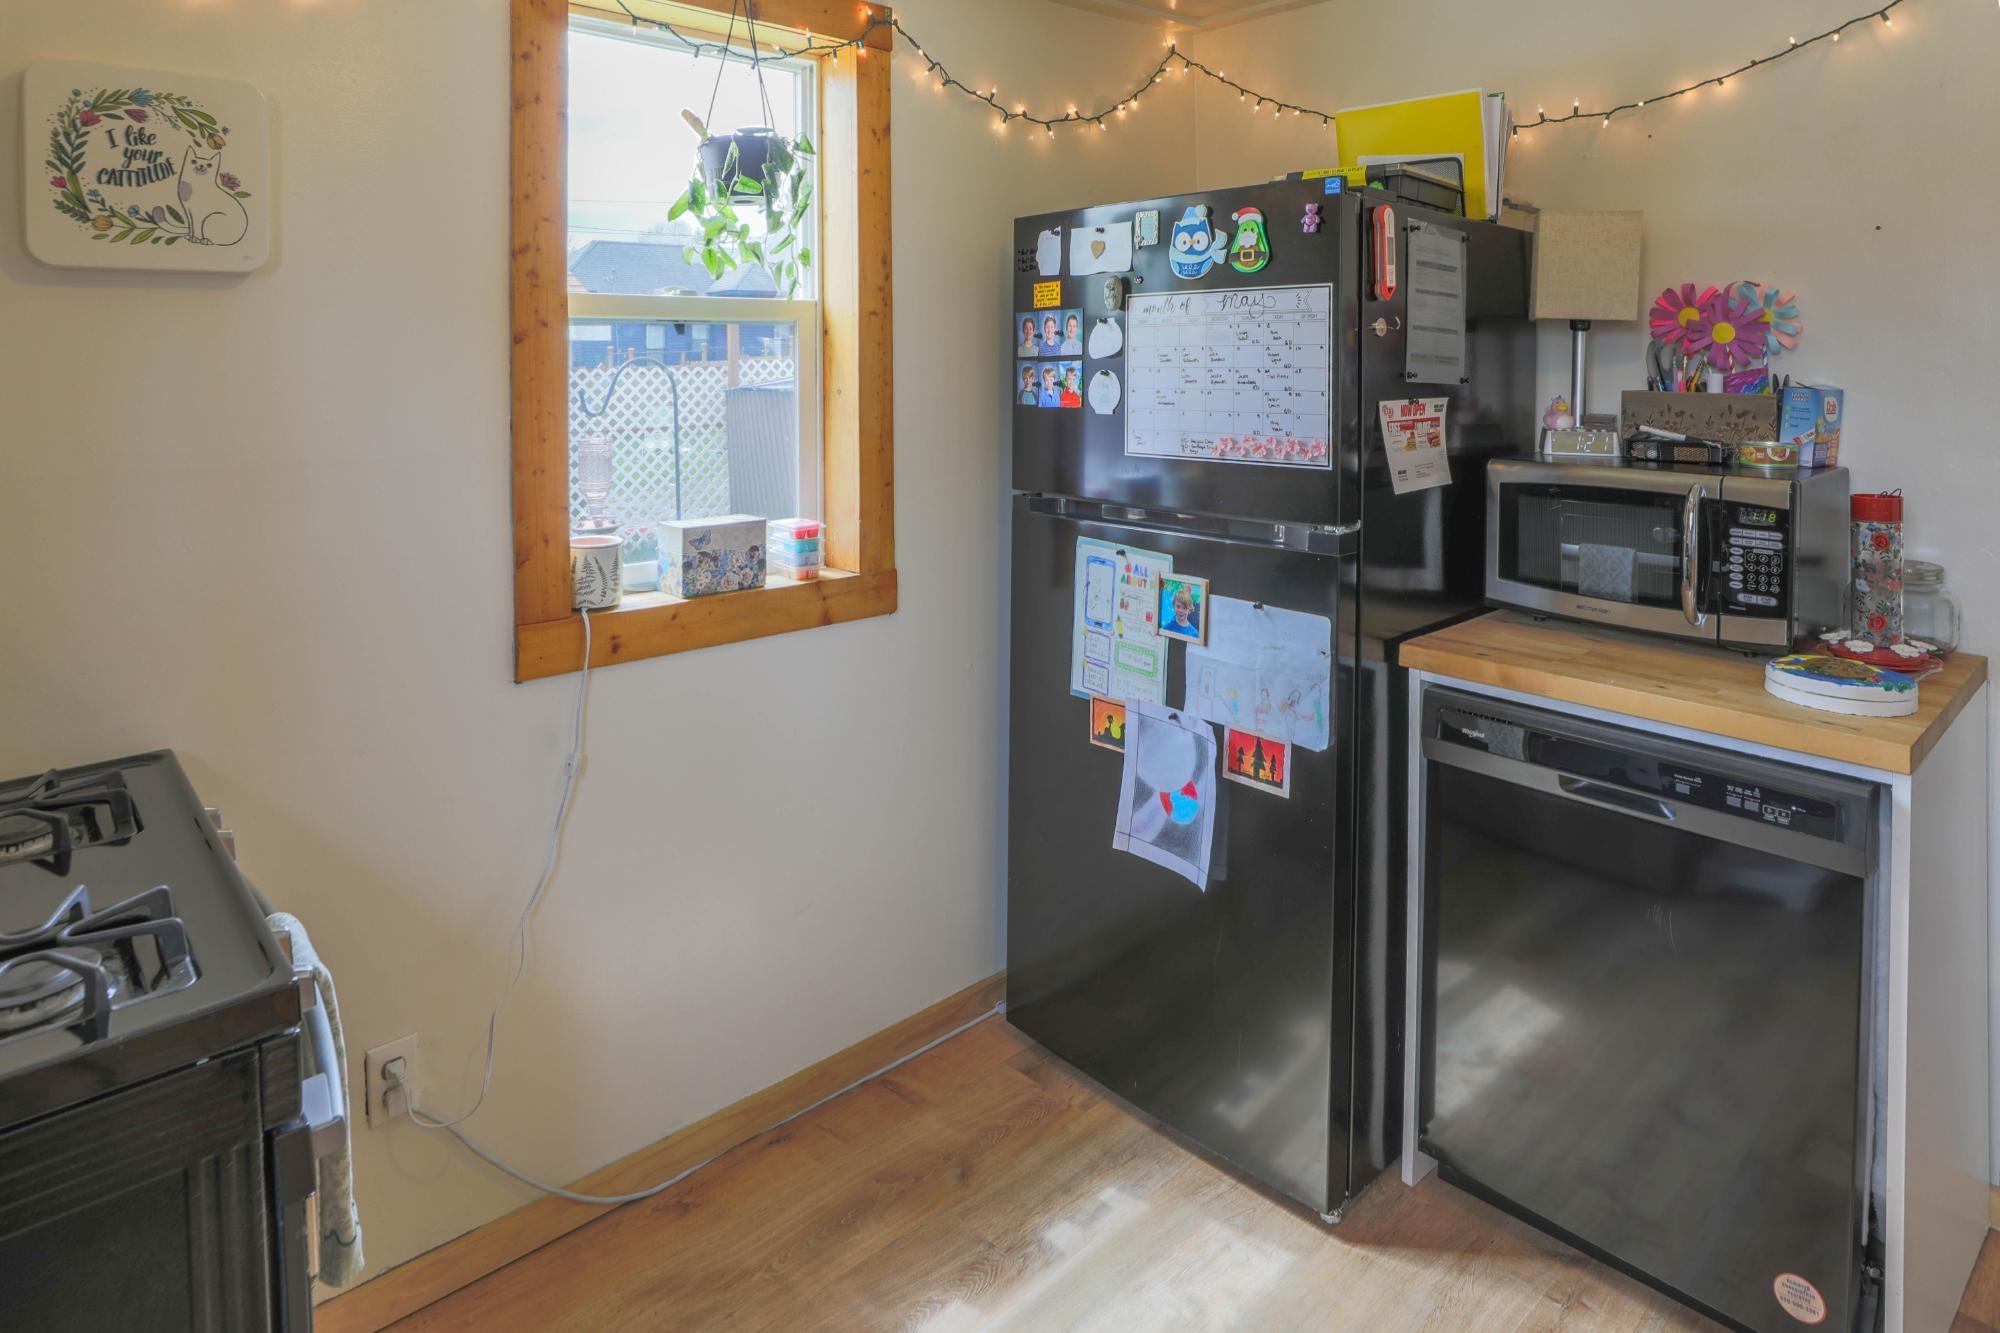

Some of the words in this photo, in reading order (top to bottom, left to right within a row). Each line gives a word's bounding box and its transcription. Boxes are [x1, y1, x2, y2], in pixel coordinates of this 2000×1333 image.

[105, 128, 120, 149] I
[125, 124, 157, 146] like
[121, 147, 163, 169] your
[97, 157, 178, 187] CATTITUDE
[1413, 402, 1426, 416] OPEN
[1753, 512, 1776, 522] 1:18
[1133, 564, 1149, 578] ALL
[1120, 574, 1147, 588] ABOUT
